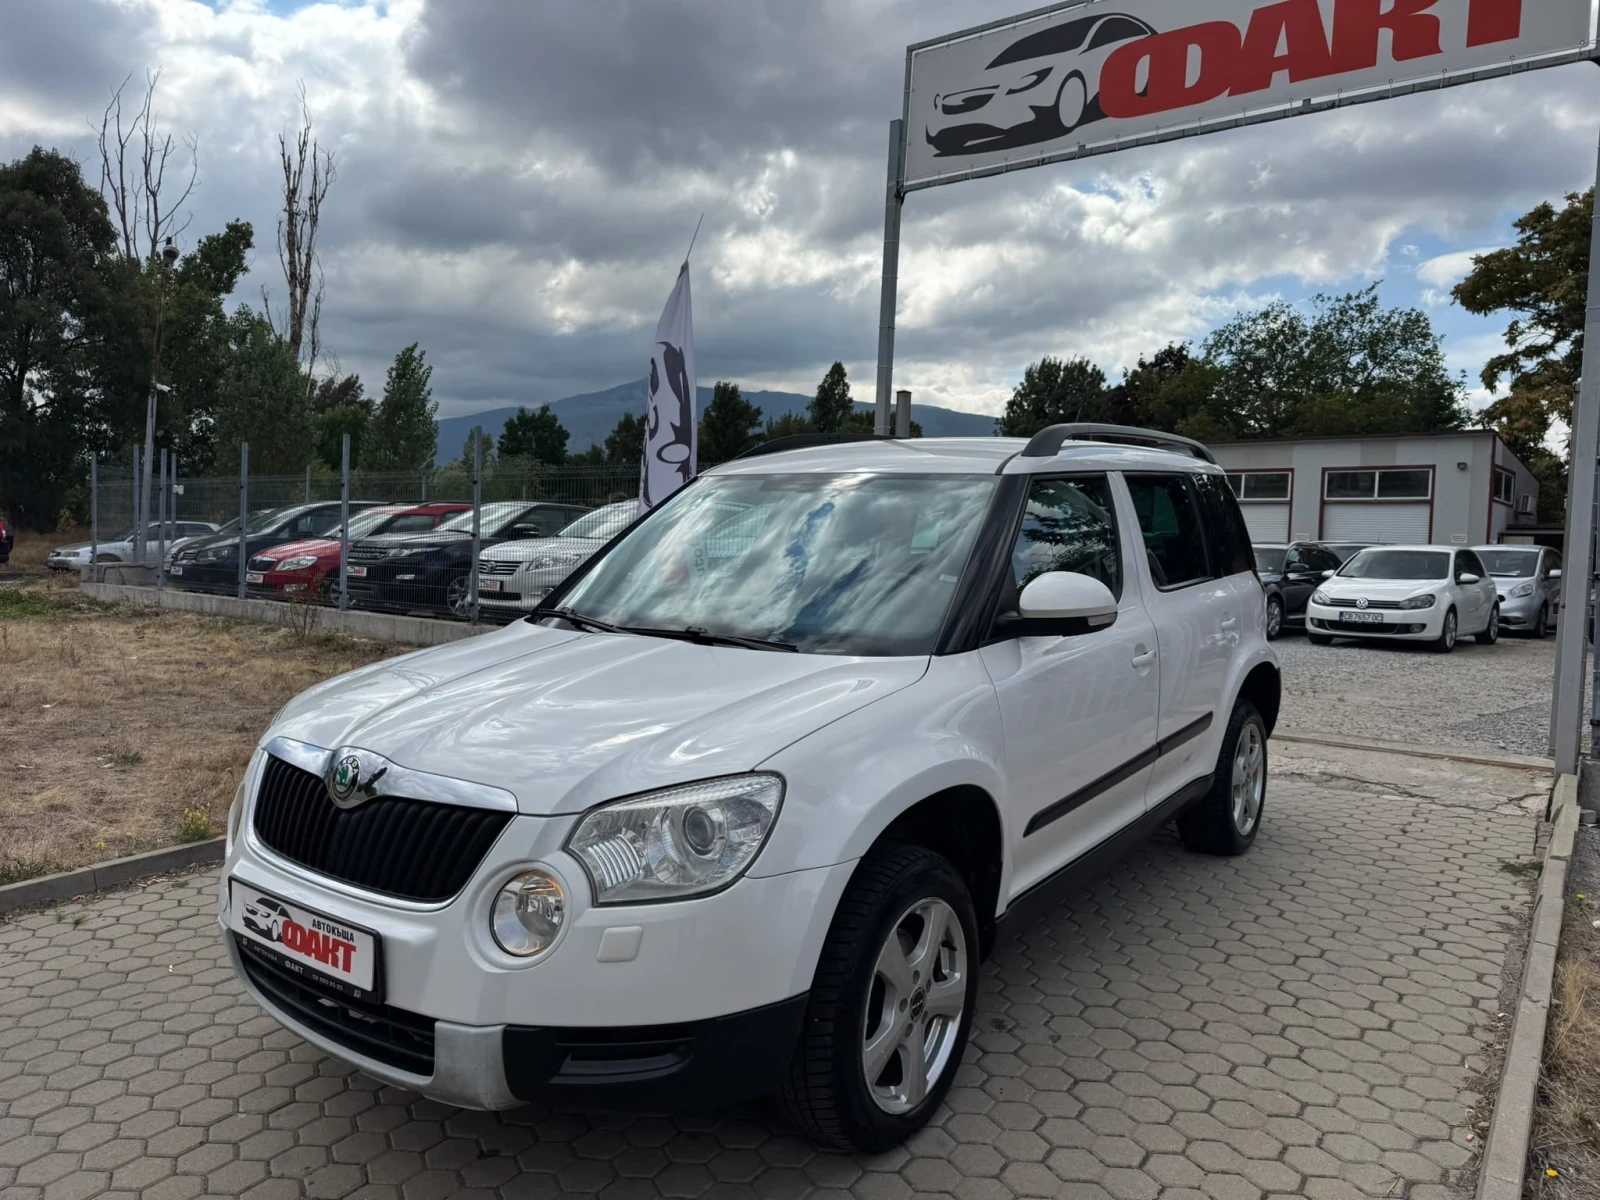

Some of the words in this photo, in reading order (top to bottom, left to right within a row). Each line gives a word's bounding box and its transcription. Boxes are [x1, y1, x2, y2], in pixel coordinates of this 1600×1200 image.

[313, 919, 354, 943] АВТОКЪЩА
[282, 919, 357, 974] ФАКТ
[284, 960, 304, 974] ФАКТ
